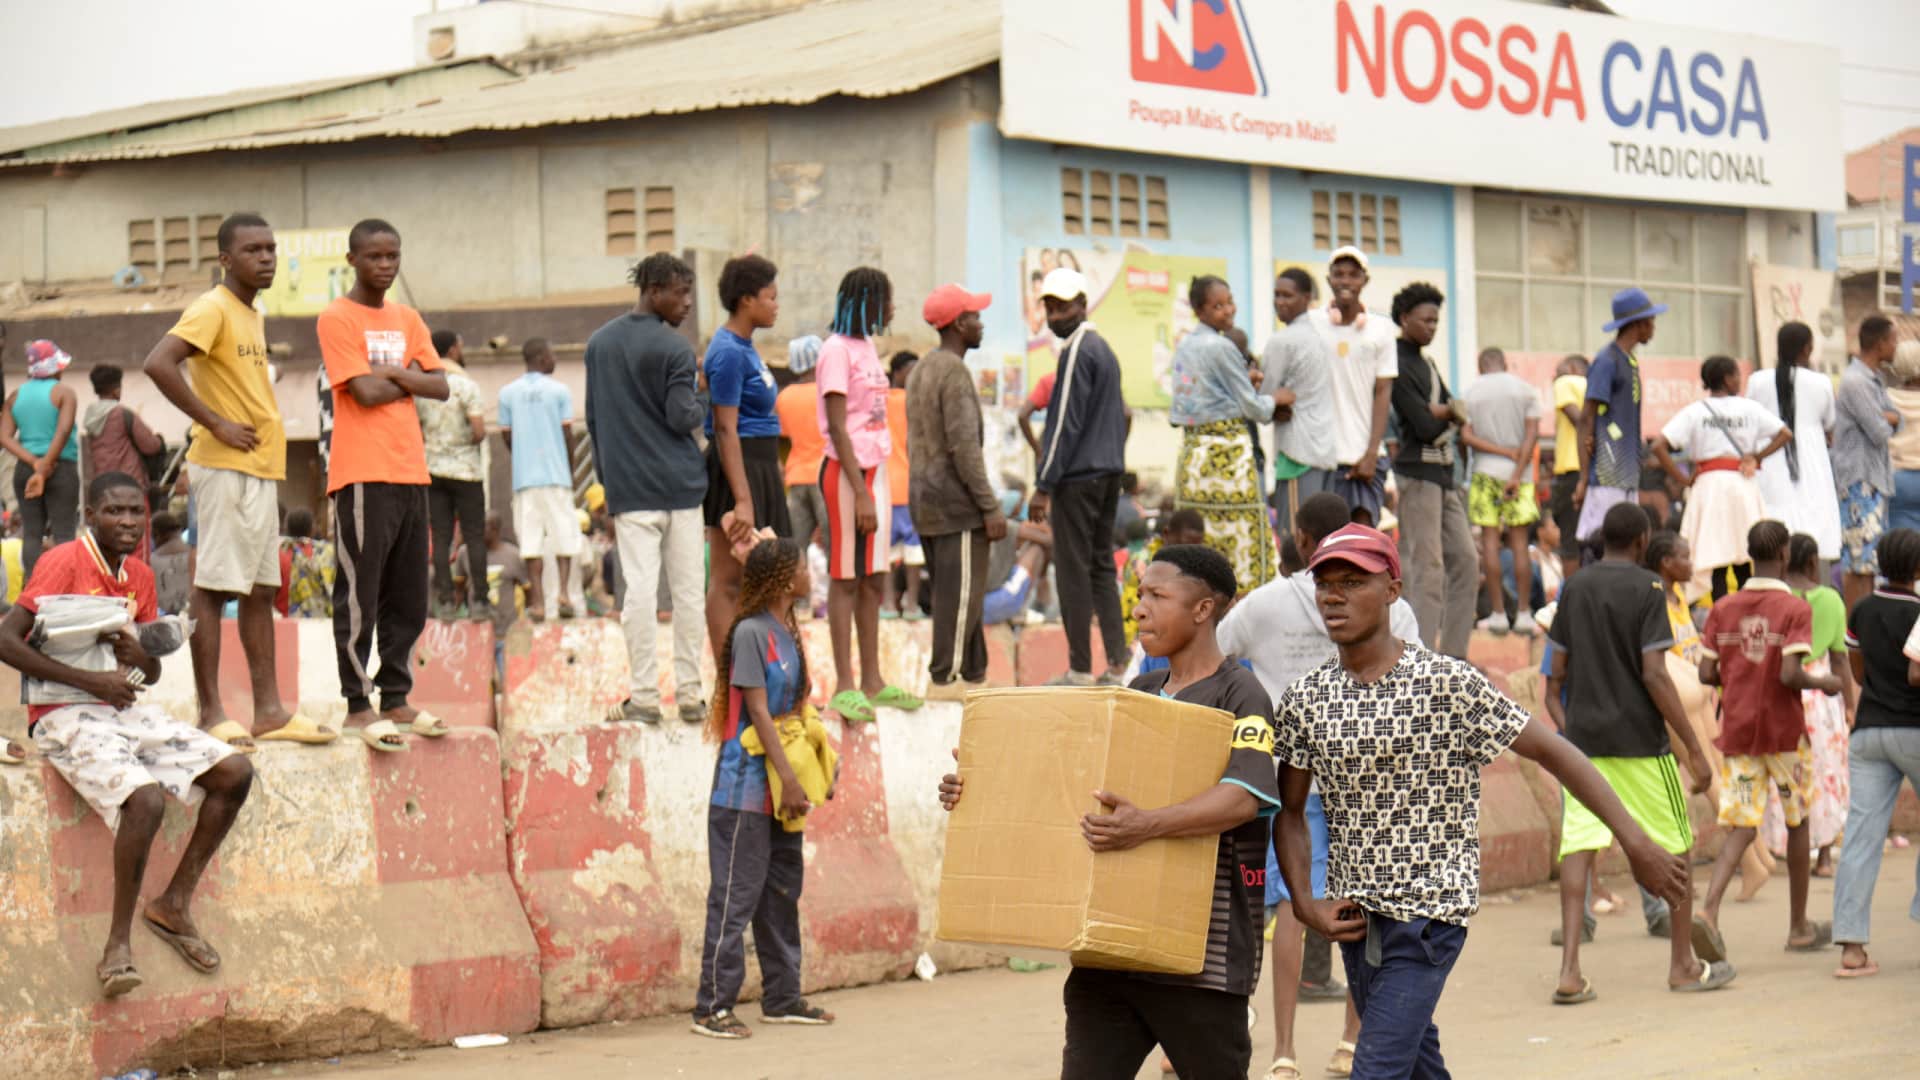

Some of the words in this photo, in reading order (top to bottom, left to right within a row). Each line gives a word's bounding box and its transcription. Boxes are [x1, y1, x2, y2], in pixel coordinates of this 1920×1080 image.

[1335, 0, 1586, 122] NOSSA
[1600, 39, 1770, 142] CASA
[1128, 99, 1182, 131] Poupa
[1186, 106, 1228, 134] Mais,
[1230, 112, 1293, 142] Compra
[1296, 120, 1337, 143] Mais!
[1609, 140, 1772, 187] TRADICIONAL
